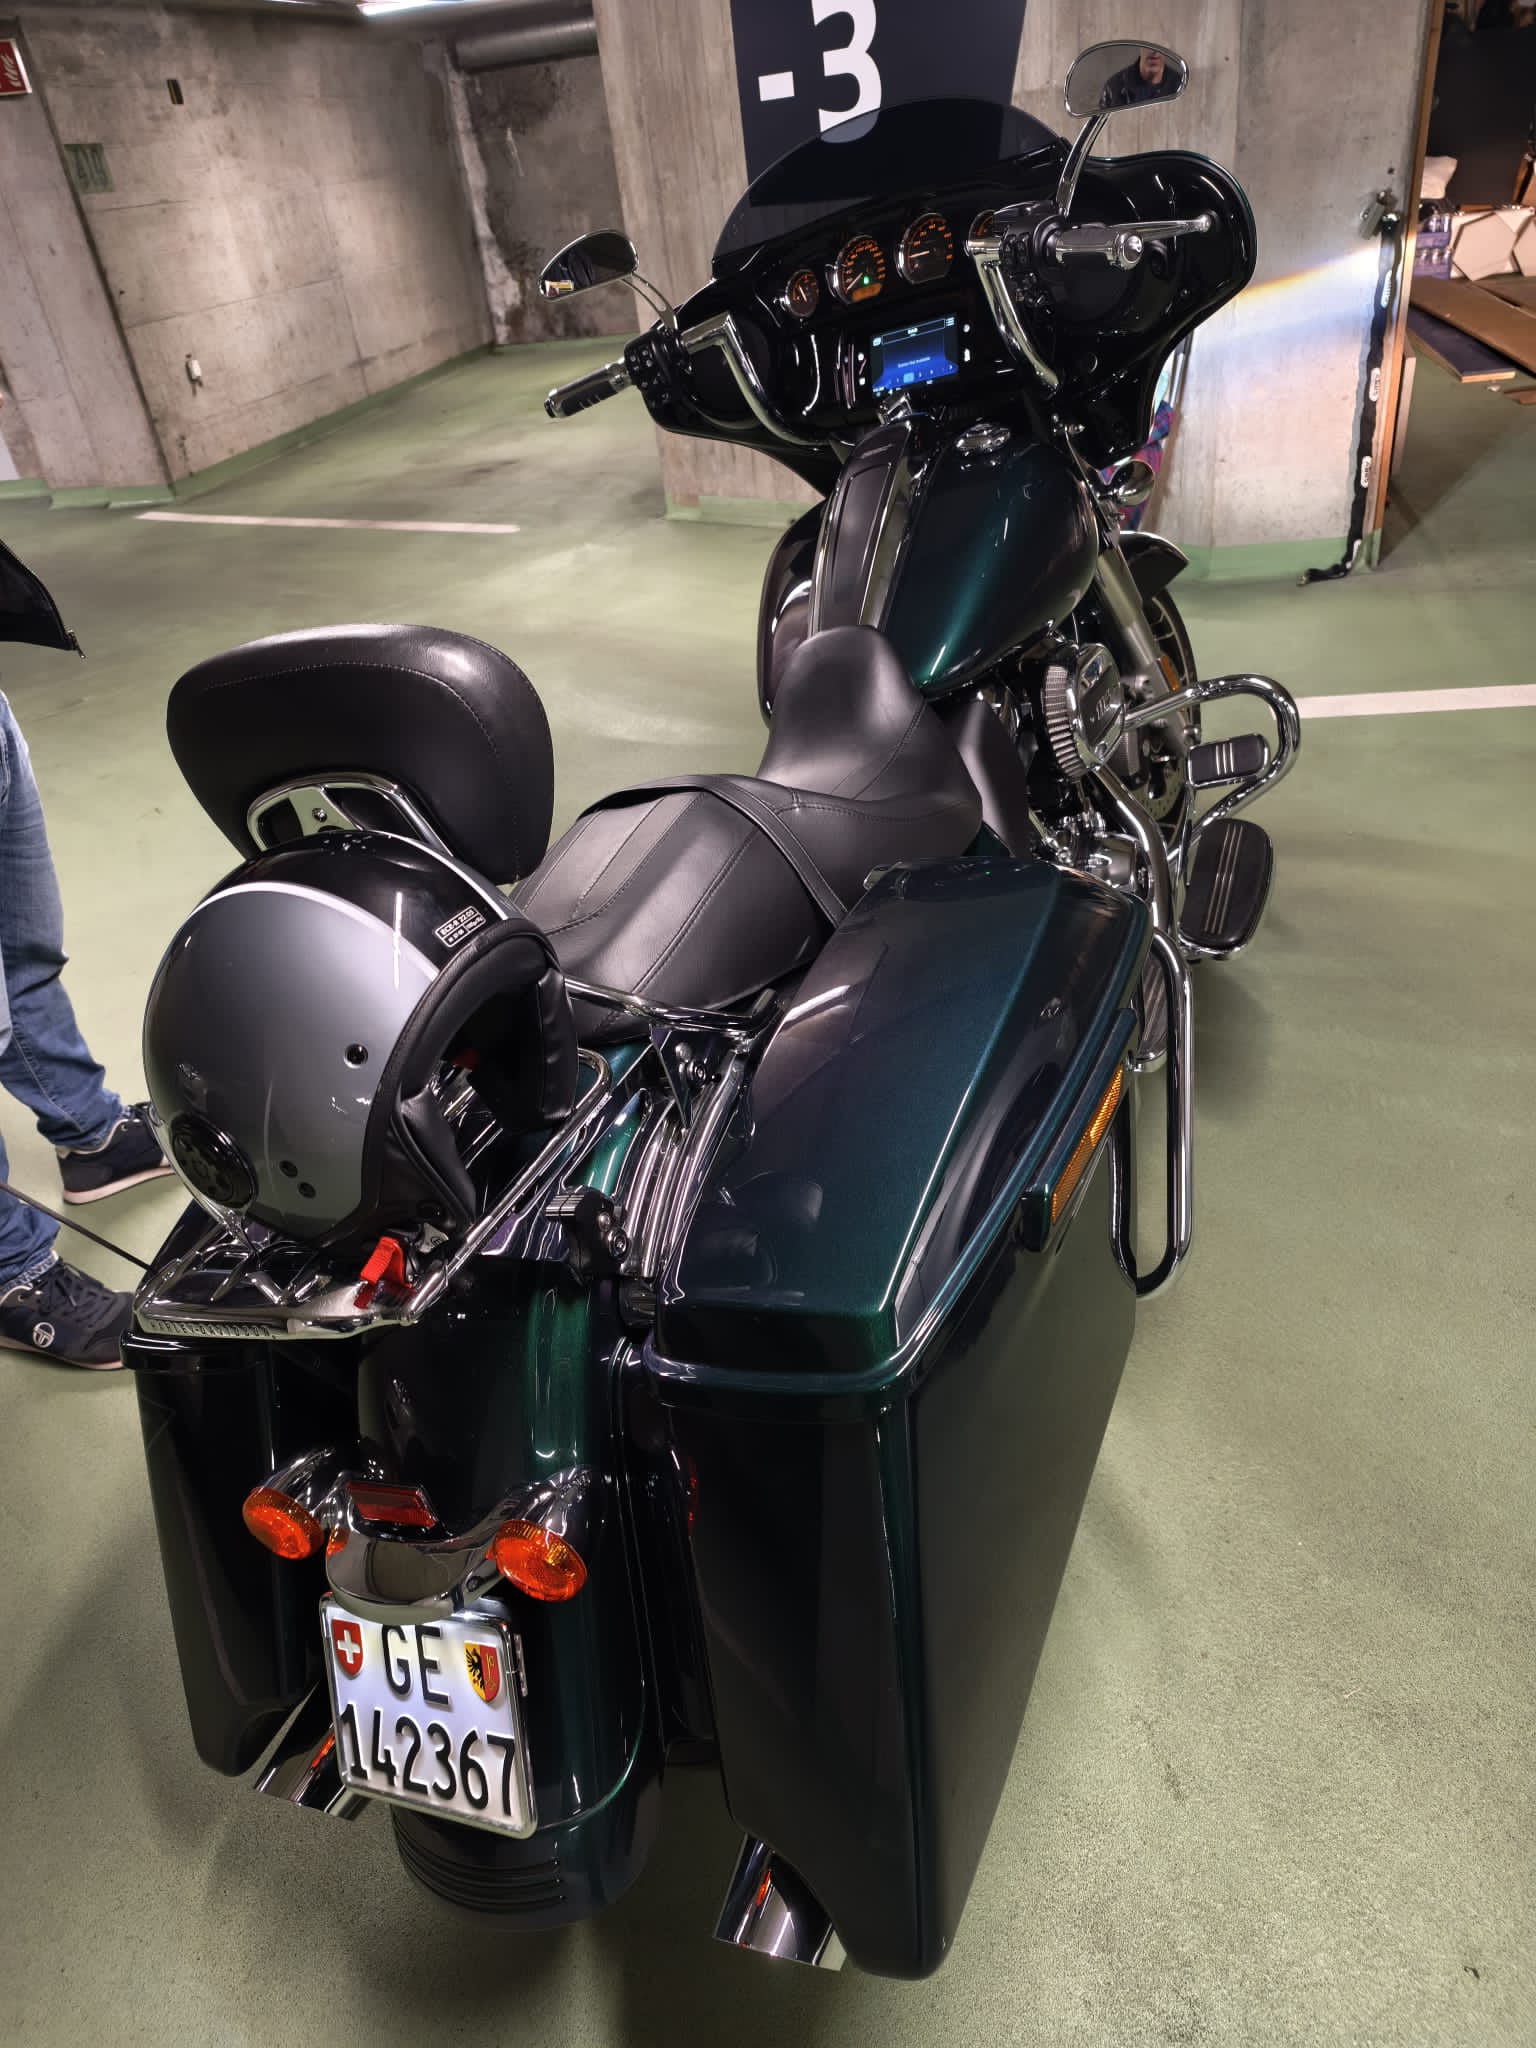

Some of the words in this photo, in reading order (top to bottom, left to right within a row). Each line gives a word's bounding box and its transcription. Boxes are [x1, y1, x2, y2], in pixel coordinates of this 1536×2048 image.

[758, 0, 882, 143] -3
[382, 1624, 450, 1705] GE
[339, 1703, 515, 1817] 142367
